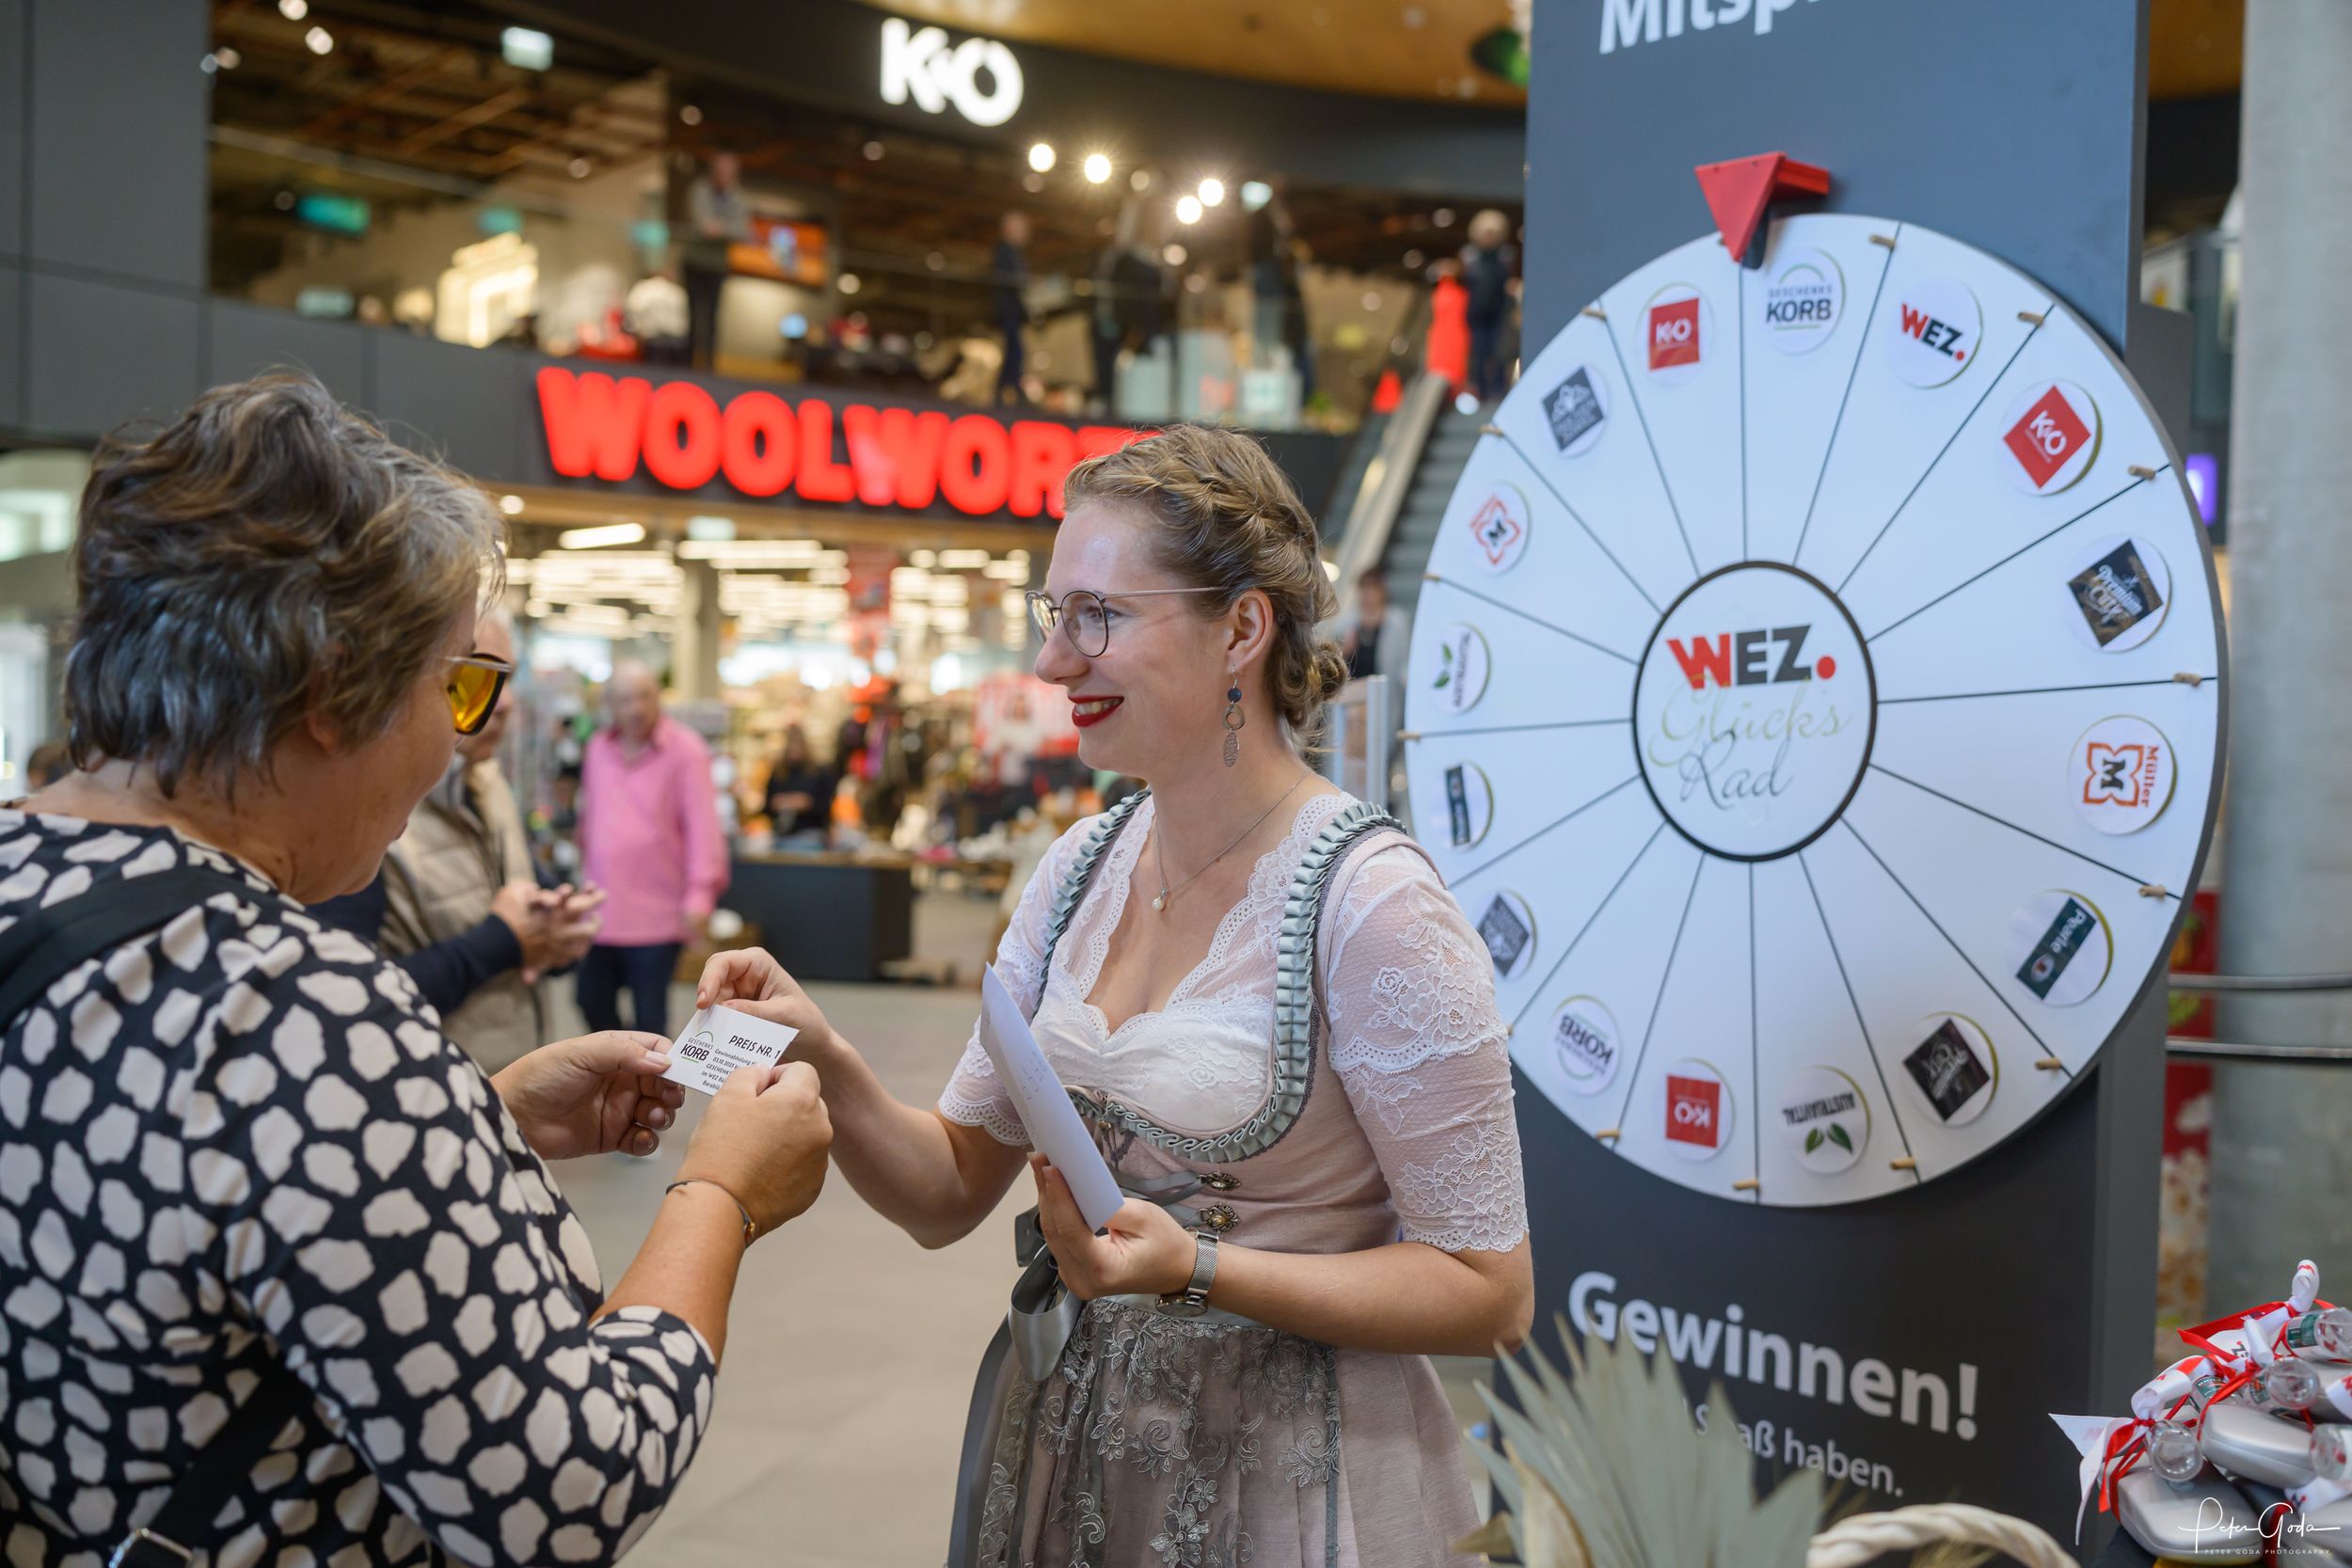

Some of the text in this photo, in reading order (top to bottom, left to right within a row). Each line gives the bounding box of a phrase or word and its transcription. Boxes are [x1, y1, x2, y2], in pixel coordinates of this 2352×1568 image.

[1766, 299, 1832, 323] KORB
[1901, 302, 1965, 361] WEZ.
[536, 366, 1162, 519] WOOLWOR
[1665, 624, 1836, 690] WEZ.
[2141, 745, 2159, 808] Müller
[2049, 908, 2087, 954] Pearle
[680, 1043, 709, 1061] KORB
[728, 1035, 758, 1052] PREIS
[755, 1044, 772, 1058] NR.
[1558, 1014, 1614, 1066] KORB
[1568, 1271, 1979, 1441] Gewinnen!
[1695, 1403, 1903, 1497] Saß haben.
